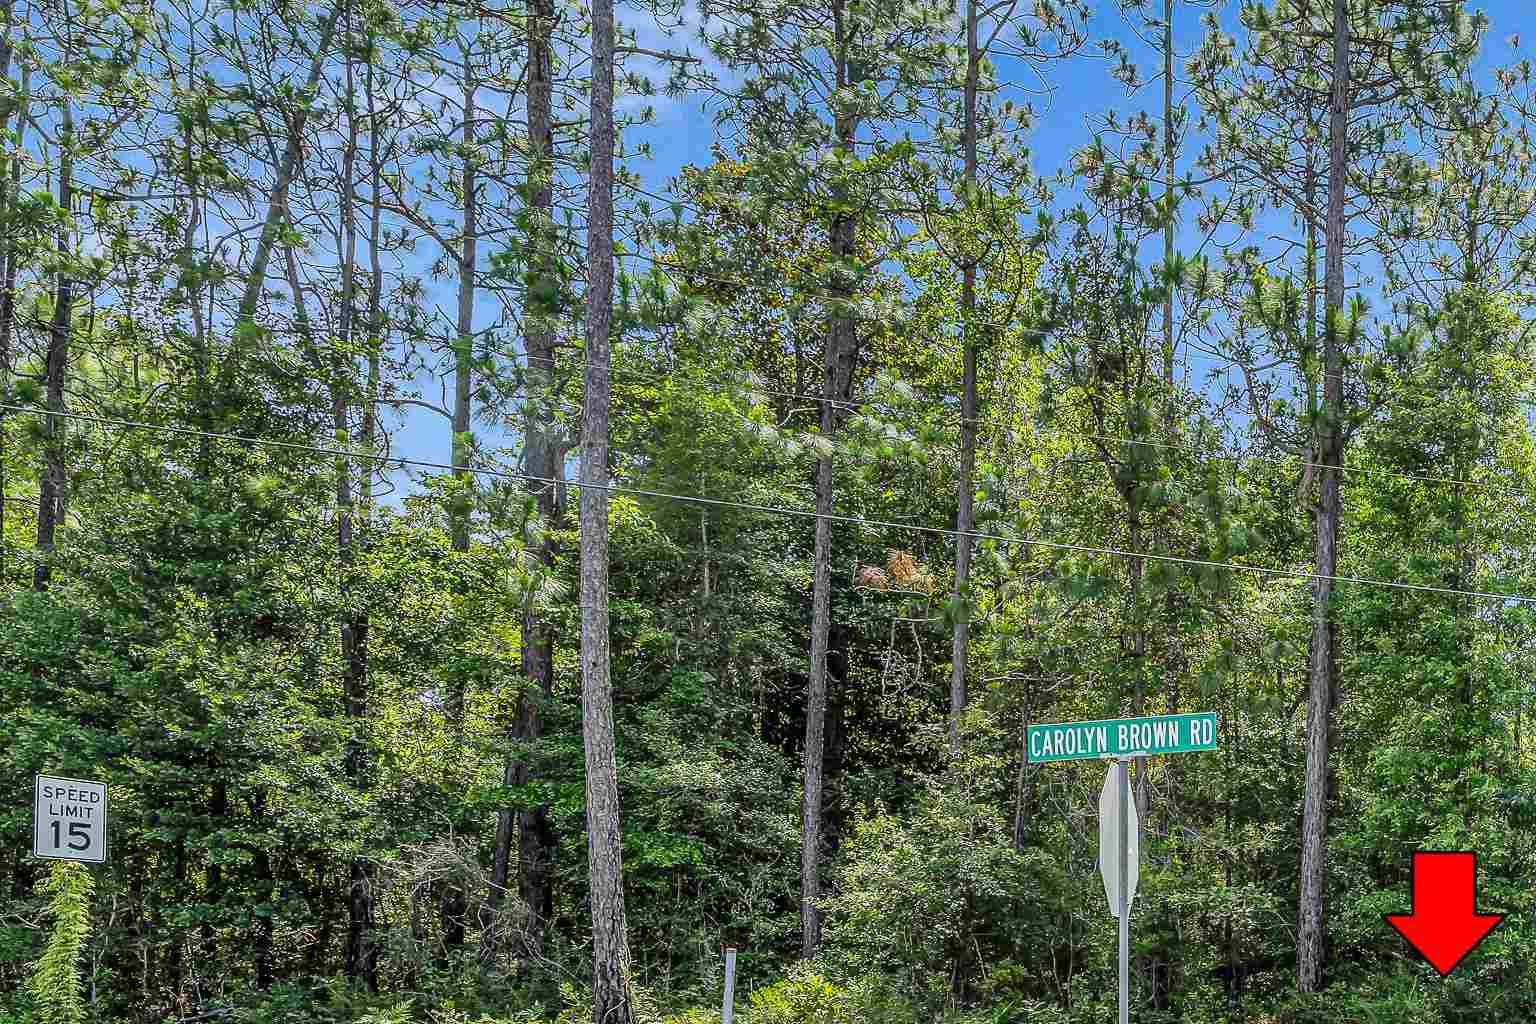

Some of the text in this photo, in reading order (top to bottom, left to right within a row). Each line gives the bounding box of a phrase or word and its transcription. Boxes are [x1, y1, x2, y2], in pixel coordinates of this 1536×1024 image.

[1031, 719, 1213, 757] CAROLYN BROWN RD
[43, 786, 100, 803] SPEED
[49, 804, 93, 818] LIMIT
[51, 820, 91, 851] 15
